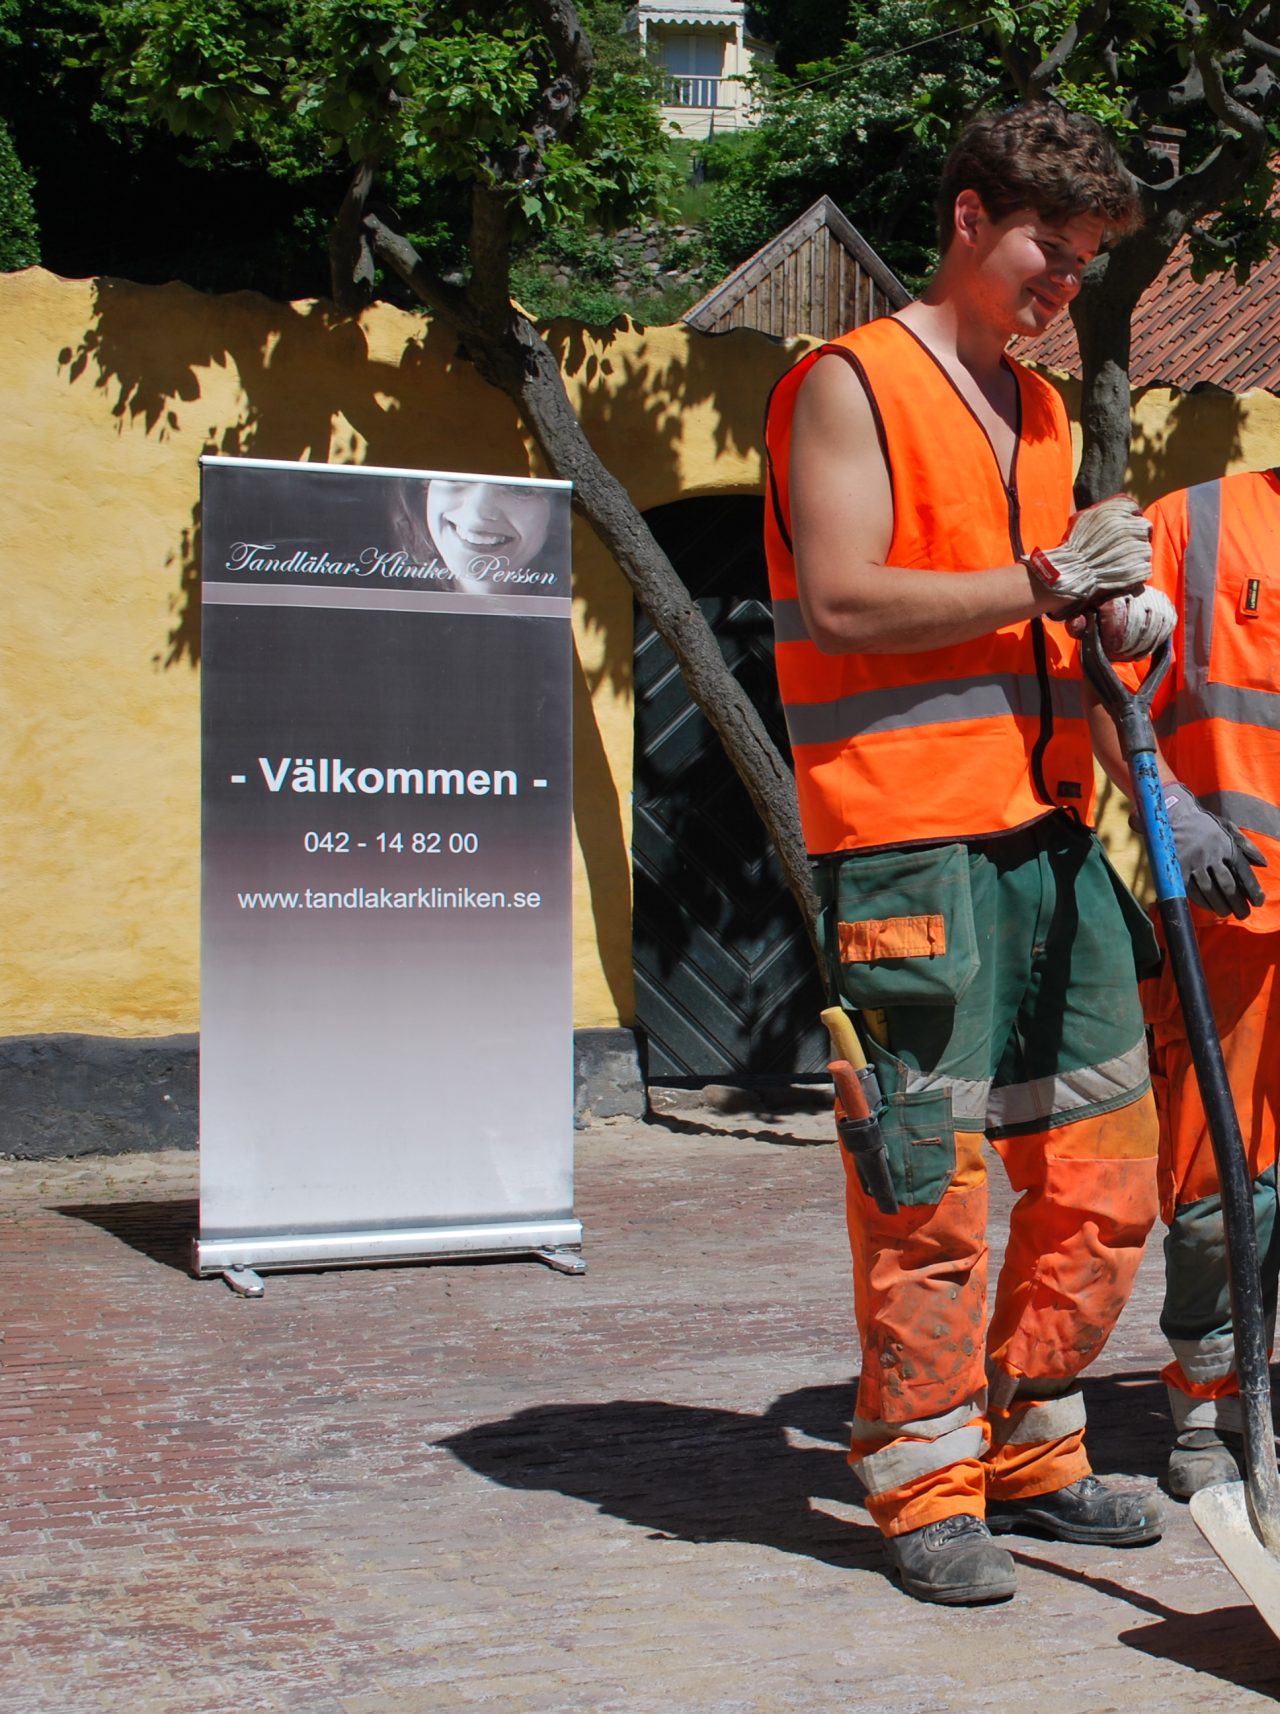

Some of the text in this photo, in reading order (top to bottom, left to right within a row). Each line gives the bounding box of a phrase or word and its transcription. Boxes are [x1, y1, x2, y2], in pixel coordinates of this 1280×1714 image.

[466, 554, 558, 586] Persson
[258, 757, 518, 796] Välkommen
[304, 831, 350, 853] 042
[376, 832, 404, 853] 14
[411, 832, 441, 854] 82
[449, 832, 479, 854] 00
[237, 887, 541, 910] www.tandlakarkliniken.se
